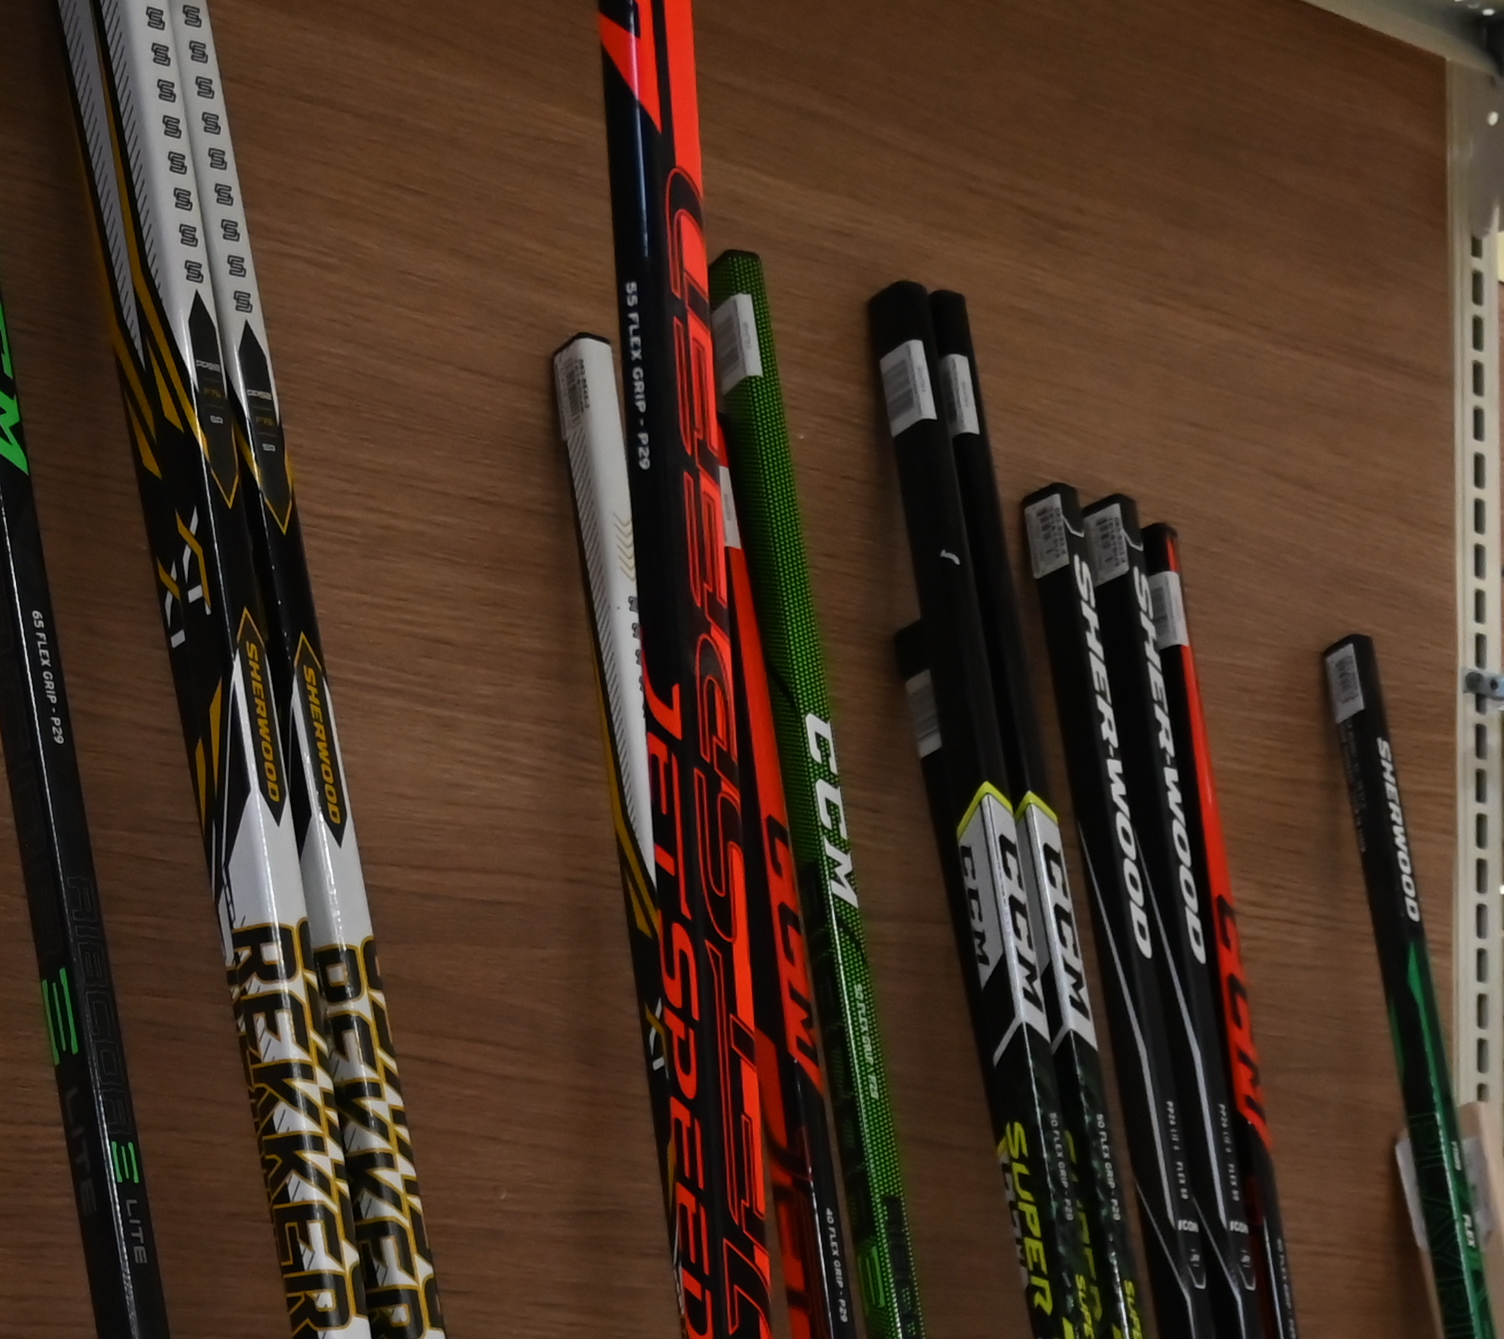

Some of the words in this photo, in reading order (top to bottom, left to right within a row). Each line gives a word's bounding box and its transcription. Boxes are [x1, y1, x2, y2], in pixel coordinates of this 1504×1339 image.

[31, 610, 43, 626] 65
[35, 630, 50, 667] FLEX
[42, 671, 58, 706] GRIP
[51, 717, 64, 745] P29
[246, 640, 280, 803] SHERWOOD
[303, 666, 342, 825] SHERWOOD
[1073, 554, 1152, 959] SHER-WOOD
[1133, 566, 1206, 964] SHER-WOOD
[805, 712, 859, 909] CCM
[1375, 738, 1421, 923] SHERWOOD
[962, 845, 990, 967] CCM
[1000, 833, 1045, 1021] CCM
[1044, 842, 1090, 1030] CCM
[1006, 1121, 1053, 1316] SUPER
